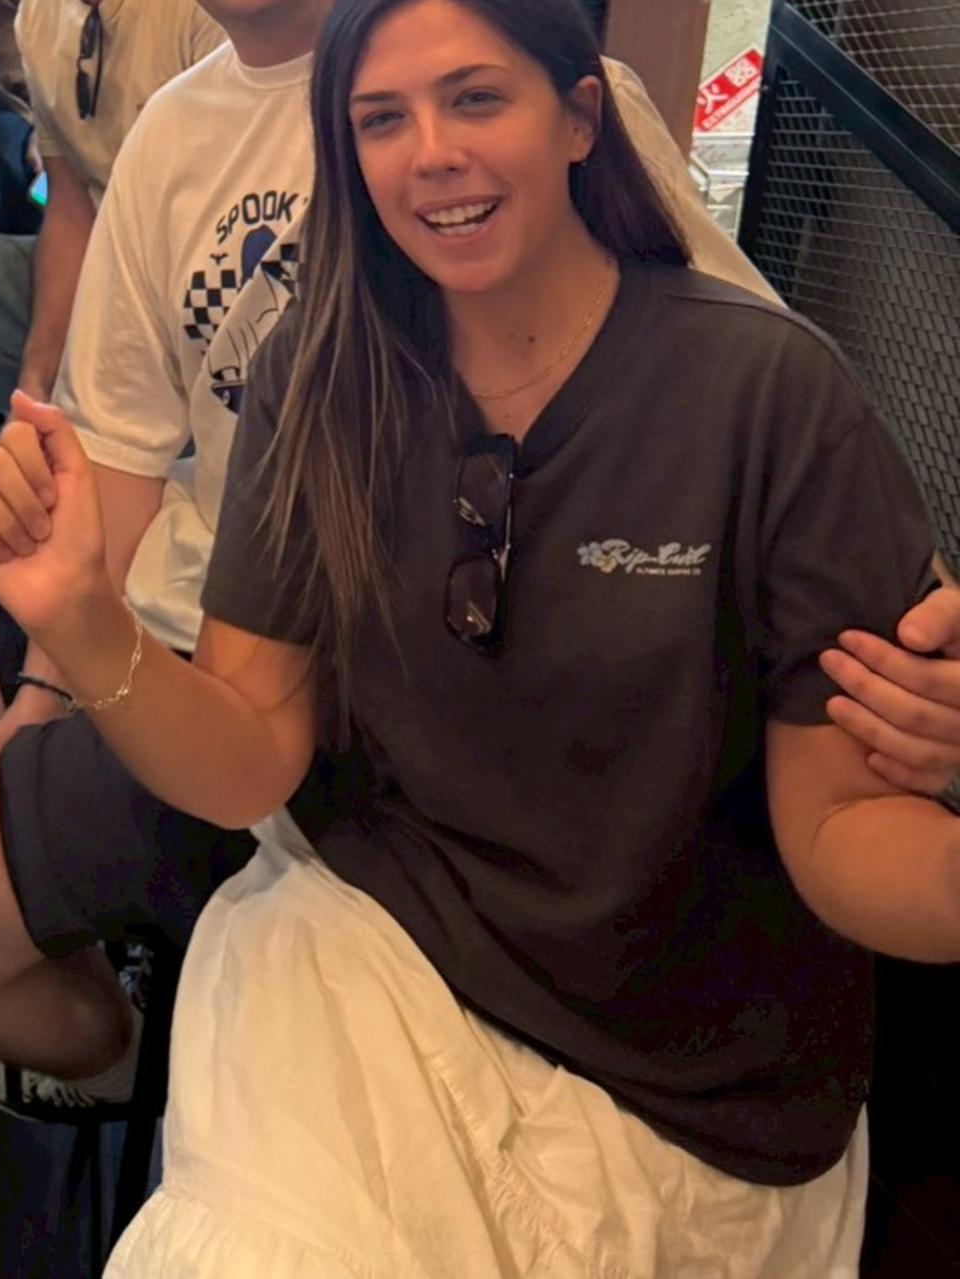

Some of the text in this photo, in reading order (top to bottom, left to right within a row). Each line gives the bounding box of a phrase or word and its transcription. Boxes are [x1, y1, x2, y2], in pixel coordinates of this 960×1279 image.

[215, 190, 308, 245] SPOOK
[601, 538, 712, 574] Rip Curl
